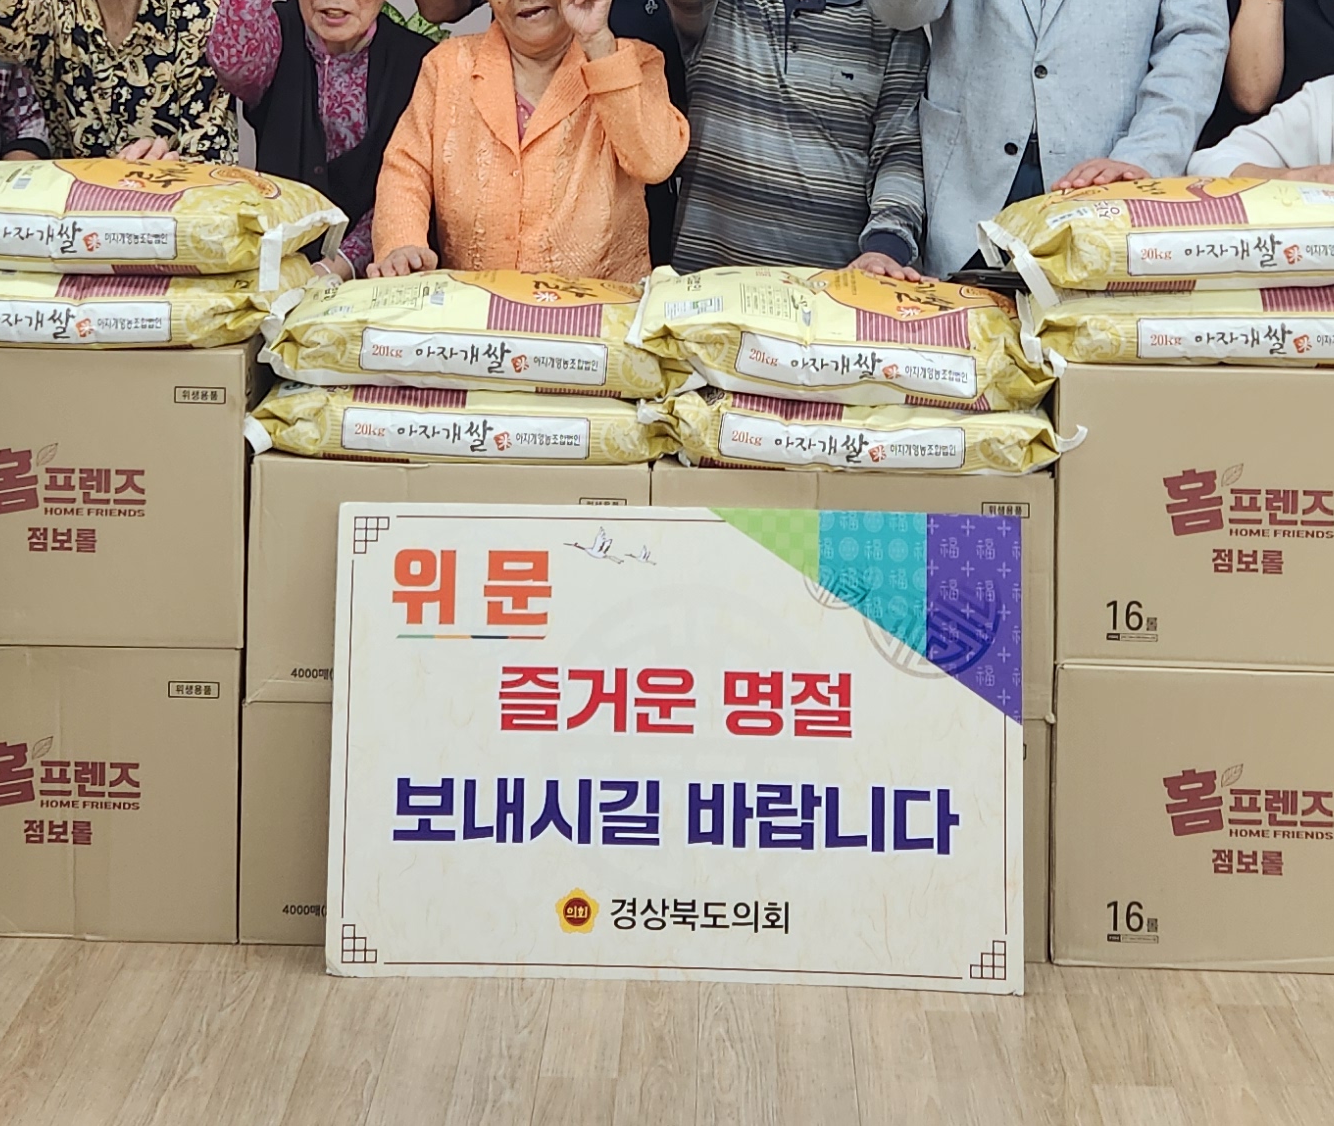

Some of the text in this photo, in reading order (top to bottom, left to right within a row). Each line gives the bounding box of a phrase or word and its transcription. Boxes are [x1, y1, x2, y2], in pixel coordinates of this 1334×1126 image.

[1140, 248, 1173, 262] 20kg
[1149, 333, 1182, 348] 20kg
[371, 344, 403, 360] 20kg
[749, 347, 779, 367] 20kg
[181, 389, 219, 402] 위생용품
[355, 422, 385, 438] 20kg
[731, 429, 763, 447] 20kg
[44, 506, 145, 518] HOME FRIENDS
[27, 527, 98, 554] 점보롤
[1229, 528, 1334, 540] HOME FRIENDS
[1211, 548, 1285, 574] 점보롤
[175, 683, 212, 696] 위생용품
[498, 665, 855, 739] 즐거운 명절
[39, 799, 141, 811] HOME FRIENDS
[392, 777, 961, 856] 보내시길 바랍니다
[23, 819, 93, 846] 점보롤
[1229, 828, 1334, 840] HOME FRIENDS
[1211, 849, 1285, 877] 점보롤
[610, 897, 791, 935] 경상북도의회
